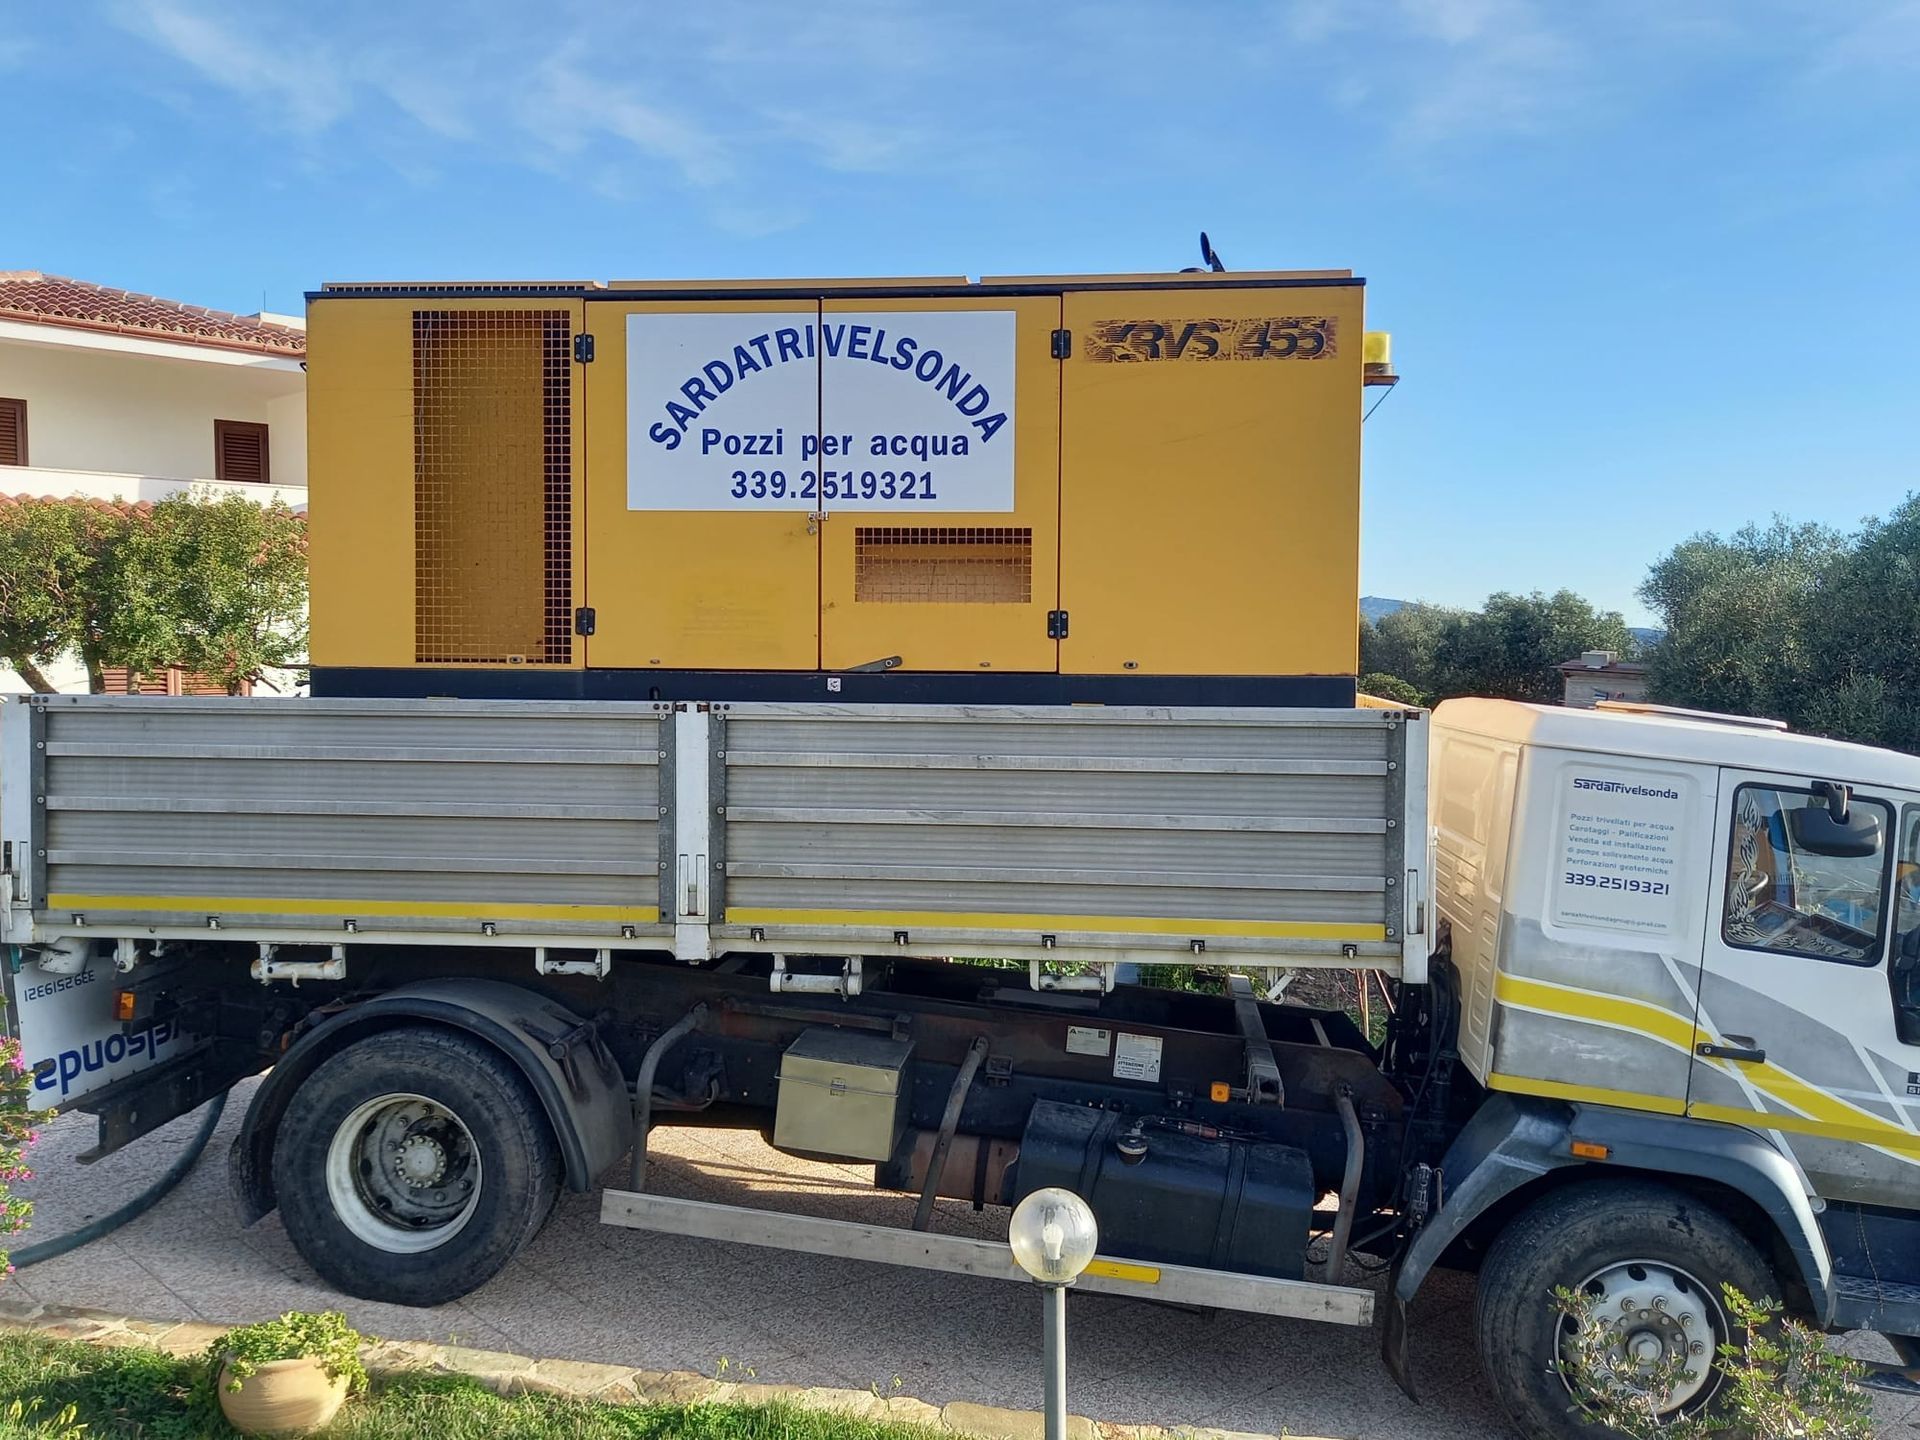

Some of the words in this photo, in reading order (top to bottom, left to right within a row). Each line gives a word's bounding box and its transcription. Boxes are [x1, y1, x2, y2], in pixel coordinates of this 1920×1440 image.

[649, 323, 1008, 451] SARDATRIVELSONDA
[702, 428, 784, 456] Pozzi
[801, 433, 853, 462] per
[870, 432, 969, 462] acqua
[731, 470, 937, 501] 339.2519321
[1573, 778, 1679, 799] SardaTrivelsonda
[1569, 824, 1610, 836] Carotaggi
[1618, 829, 1669, 841] Palificazioni
[1570, 813, 1594, 822] Pozzi
[1596, 816, 1631, 827] trivellati
[1633, 820, 1647, 829] per
[1649, 822, 1675, 832] acqua
[1568, 835, 1600, 845] Vendita
[1614, 840, 1667, 852] installazione
[1566, 857, 1617, 869] Perforazioni
[1651, 856, 1674, 865] acqua
[1564, 872, 1670, 896] 339.2519321
